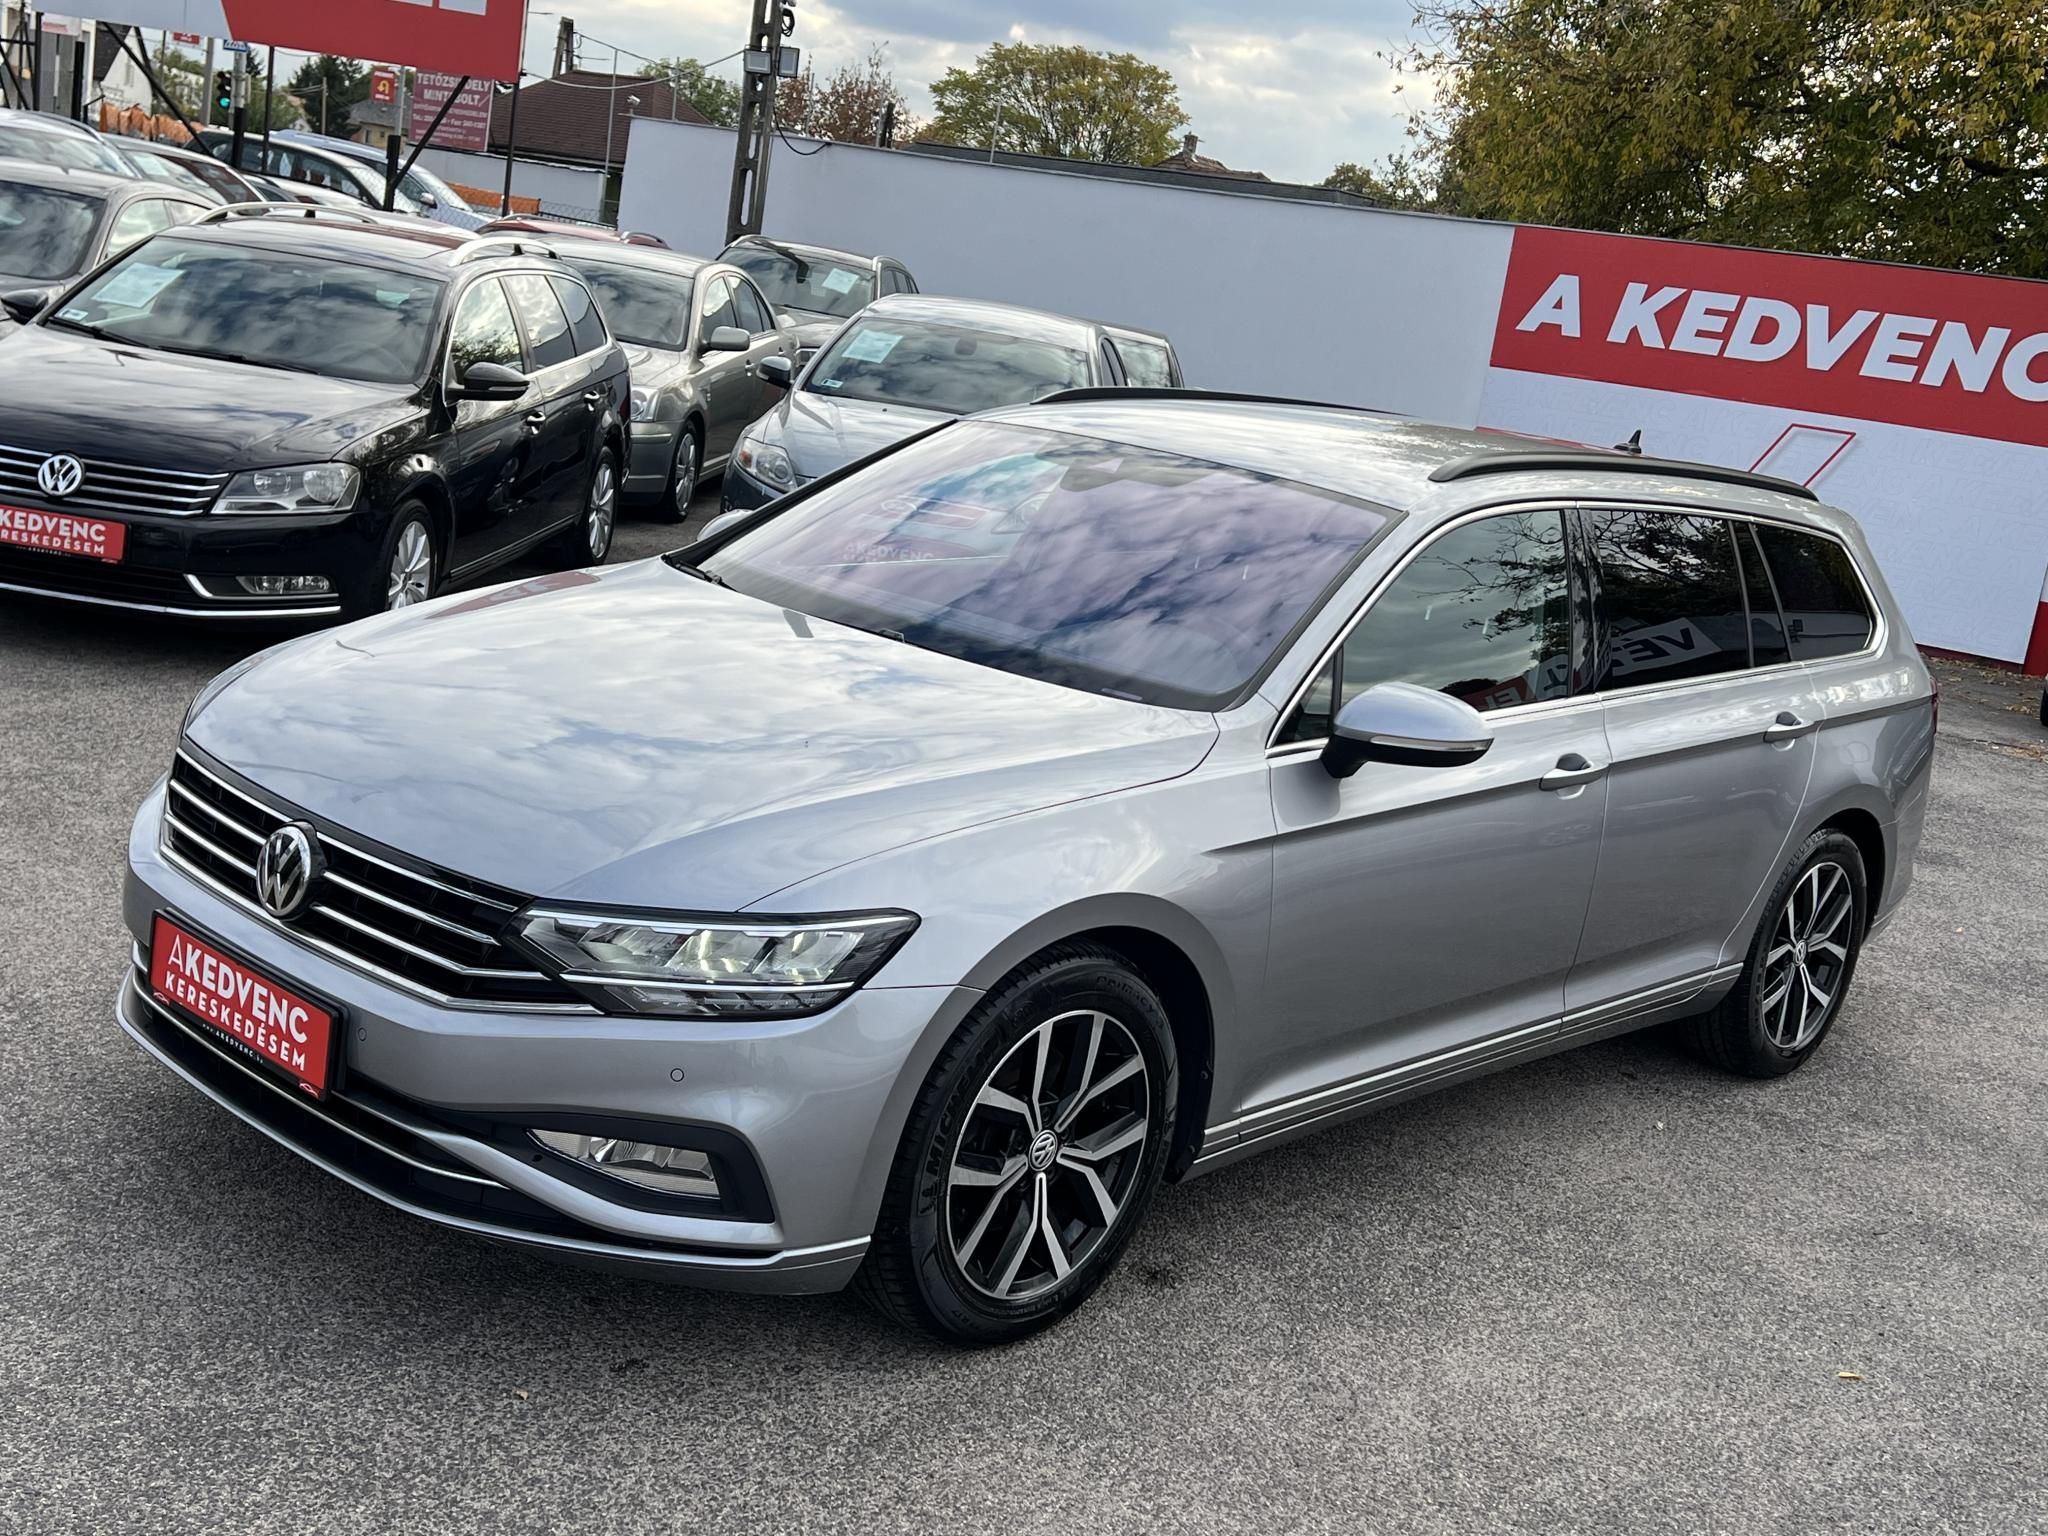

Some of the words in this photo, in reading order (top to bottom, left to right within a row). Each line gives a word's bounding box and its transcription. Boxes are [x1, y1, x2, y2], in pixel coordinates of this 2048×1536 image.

[416, 72, 490, 92] TETŐZSIDELY
[1515, 274, 1581, 338] A
[1606, 282, 2048, 402] KEDVENC
[165, 971, 305, 1072] KERESKEDÉSEM
